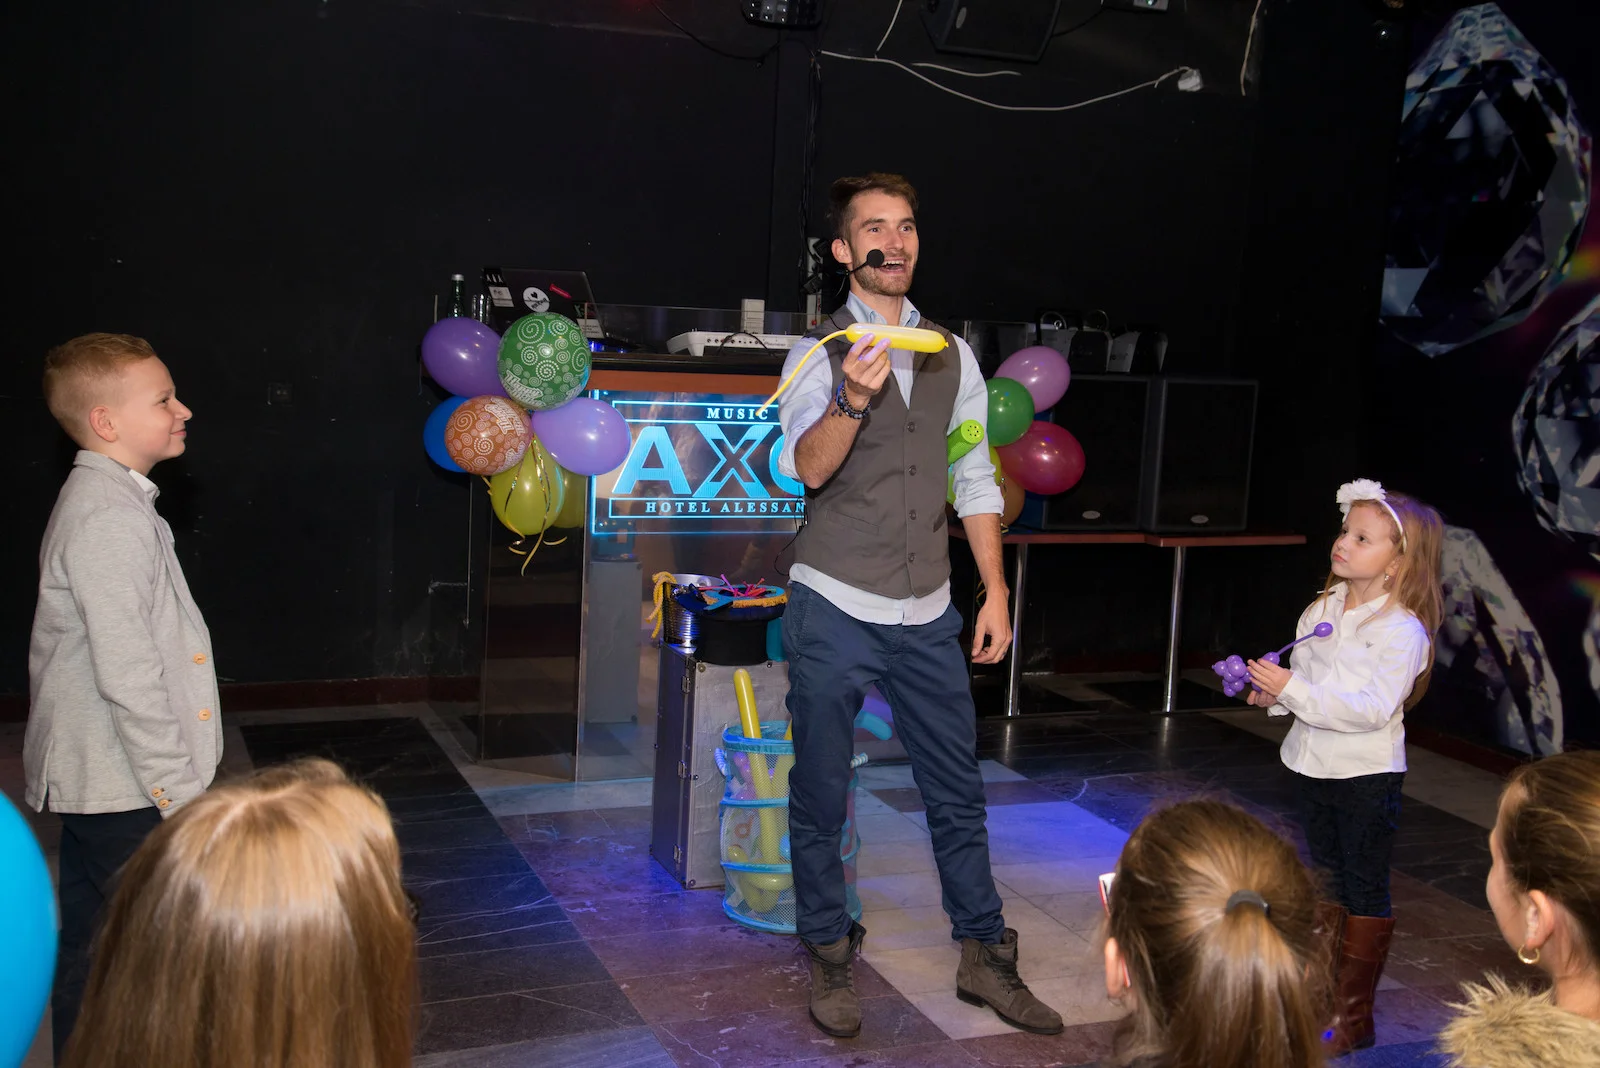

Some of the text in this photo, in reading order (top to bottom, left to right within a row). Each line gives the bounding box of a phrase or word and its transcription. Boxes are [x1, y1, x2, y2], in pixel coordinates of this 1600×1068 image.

[707, 408, 769, 420] MUSIC
[645, 502, 805, 514] HOTEL ALESSAN
